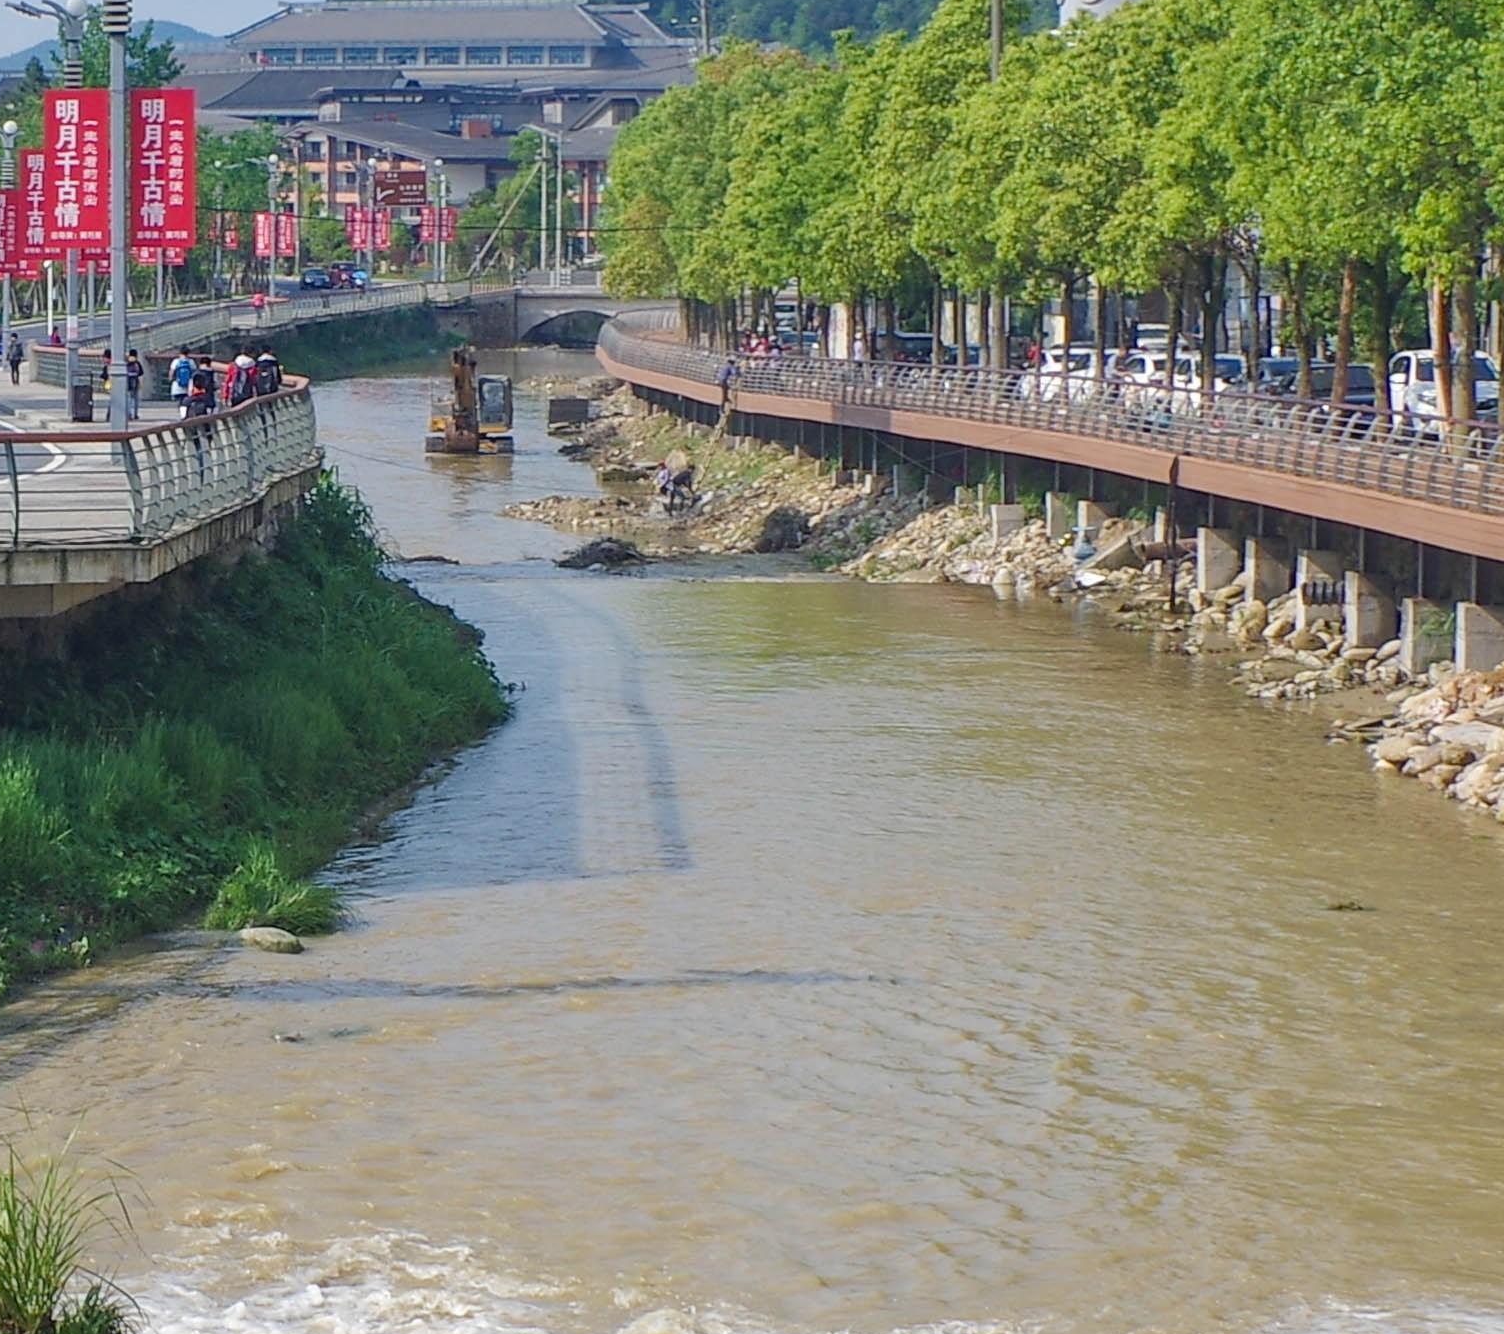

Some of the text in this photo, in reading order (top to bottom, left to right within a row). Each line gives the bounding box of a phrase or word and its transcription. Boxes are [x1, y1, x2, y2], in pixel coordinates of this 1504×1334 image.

[26, 154, 45, 245] 明月千古情
[54, 99, 80, 228] 明月千古情
[140, 98, 166, 227] 明月千古情
